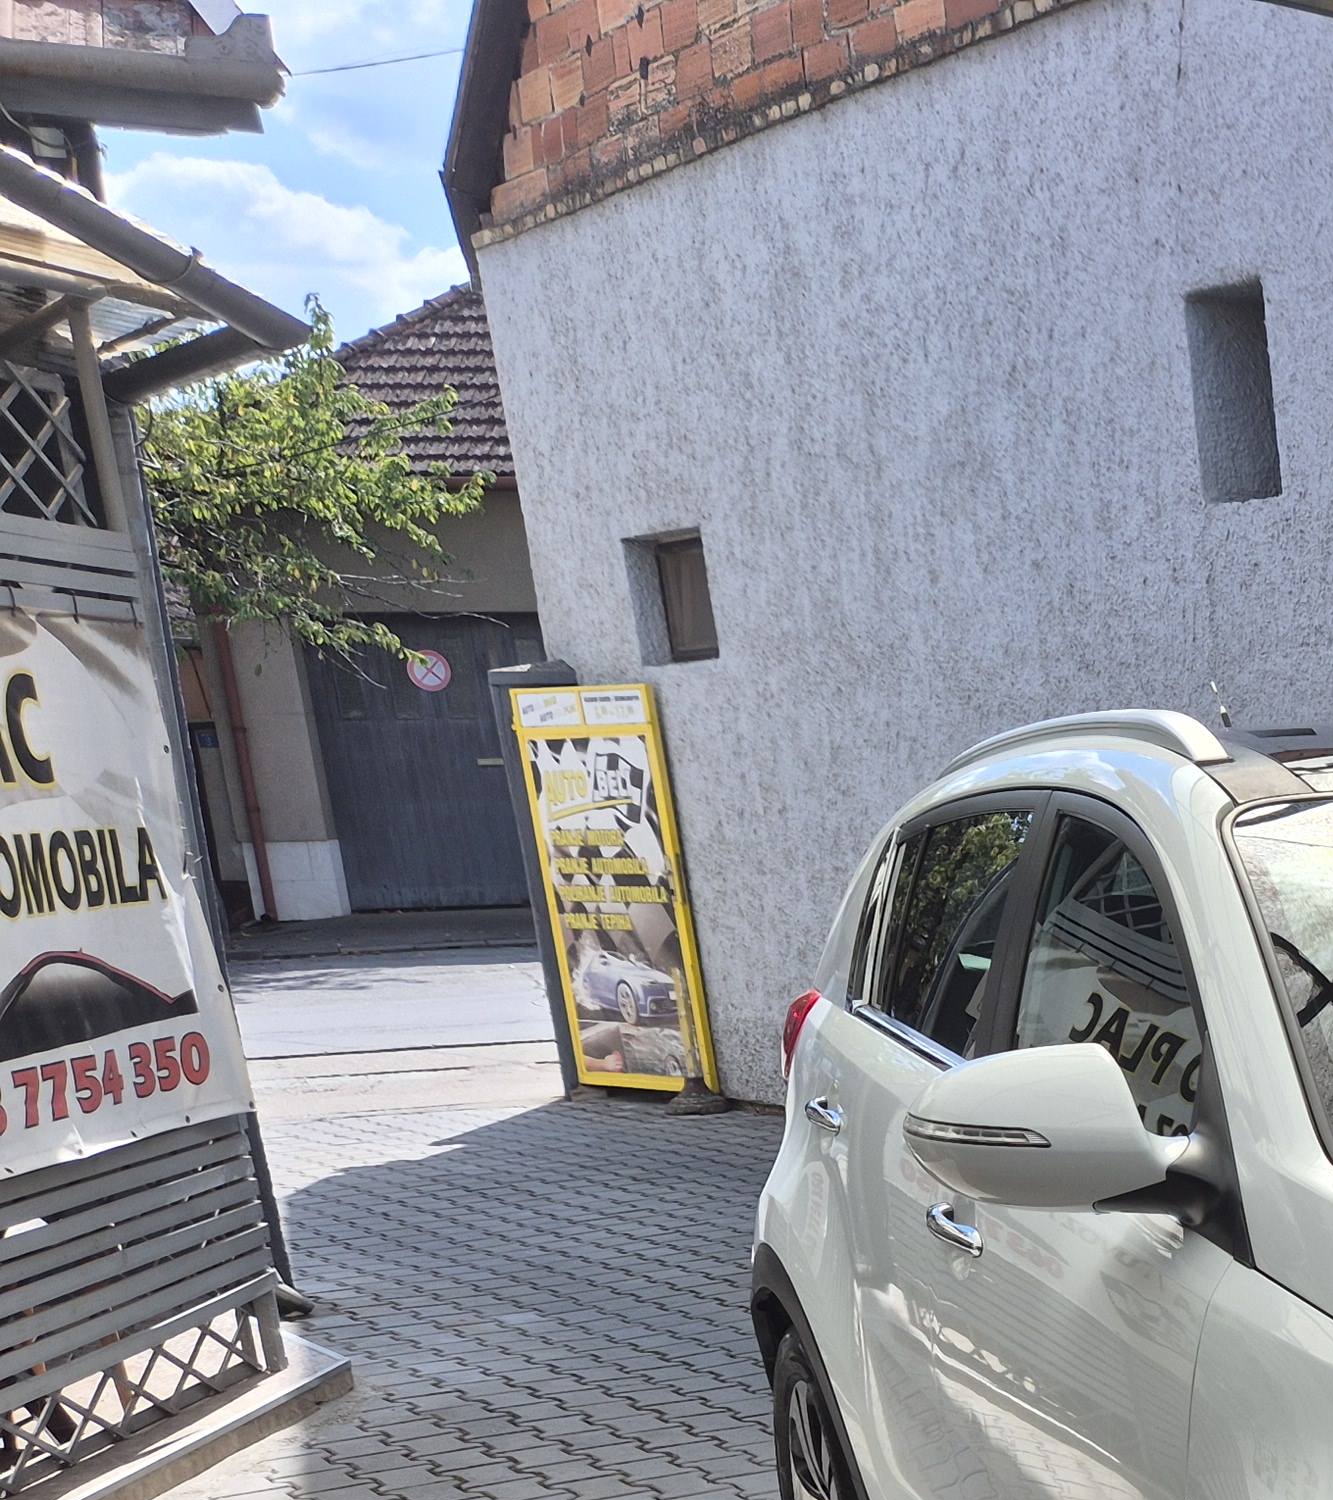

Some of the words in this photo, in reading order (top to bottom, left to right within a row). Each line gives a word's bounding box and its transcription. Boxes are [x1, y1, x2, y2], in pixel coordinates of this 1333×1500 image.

[545, 770, 589, 806] AUTO
[11, 1048, 124, 1129] 7754
[128, 1031, 210, 1098] 350
